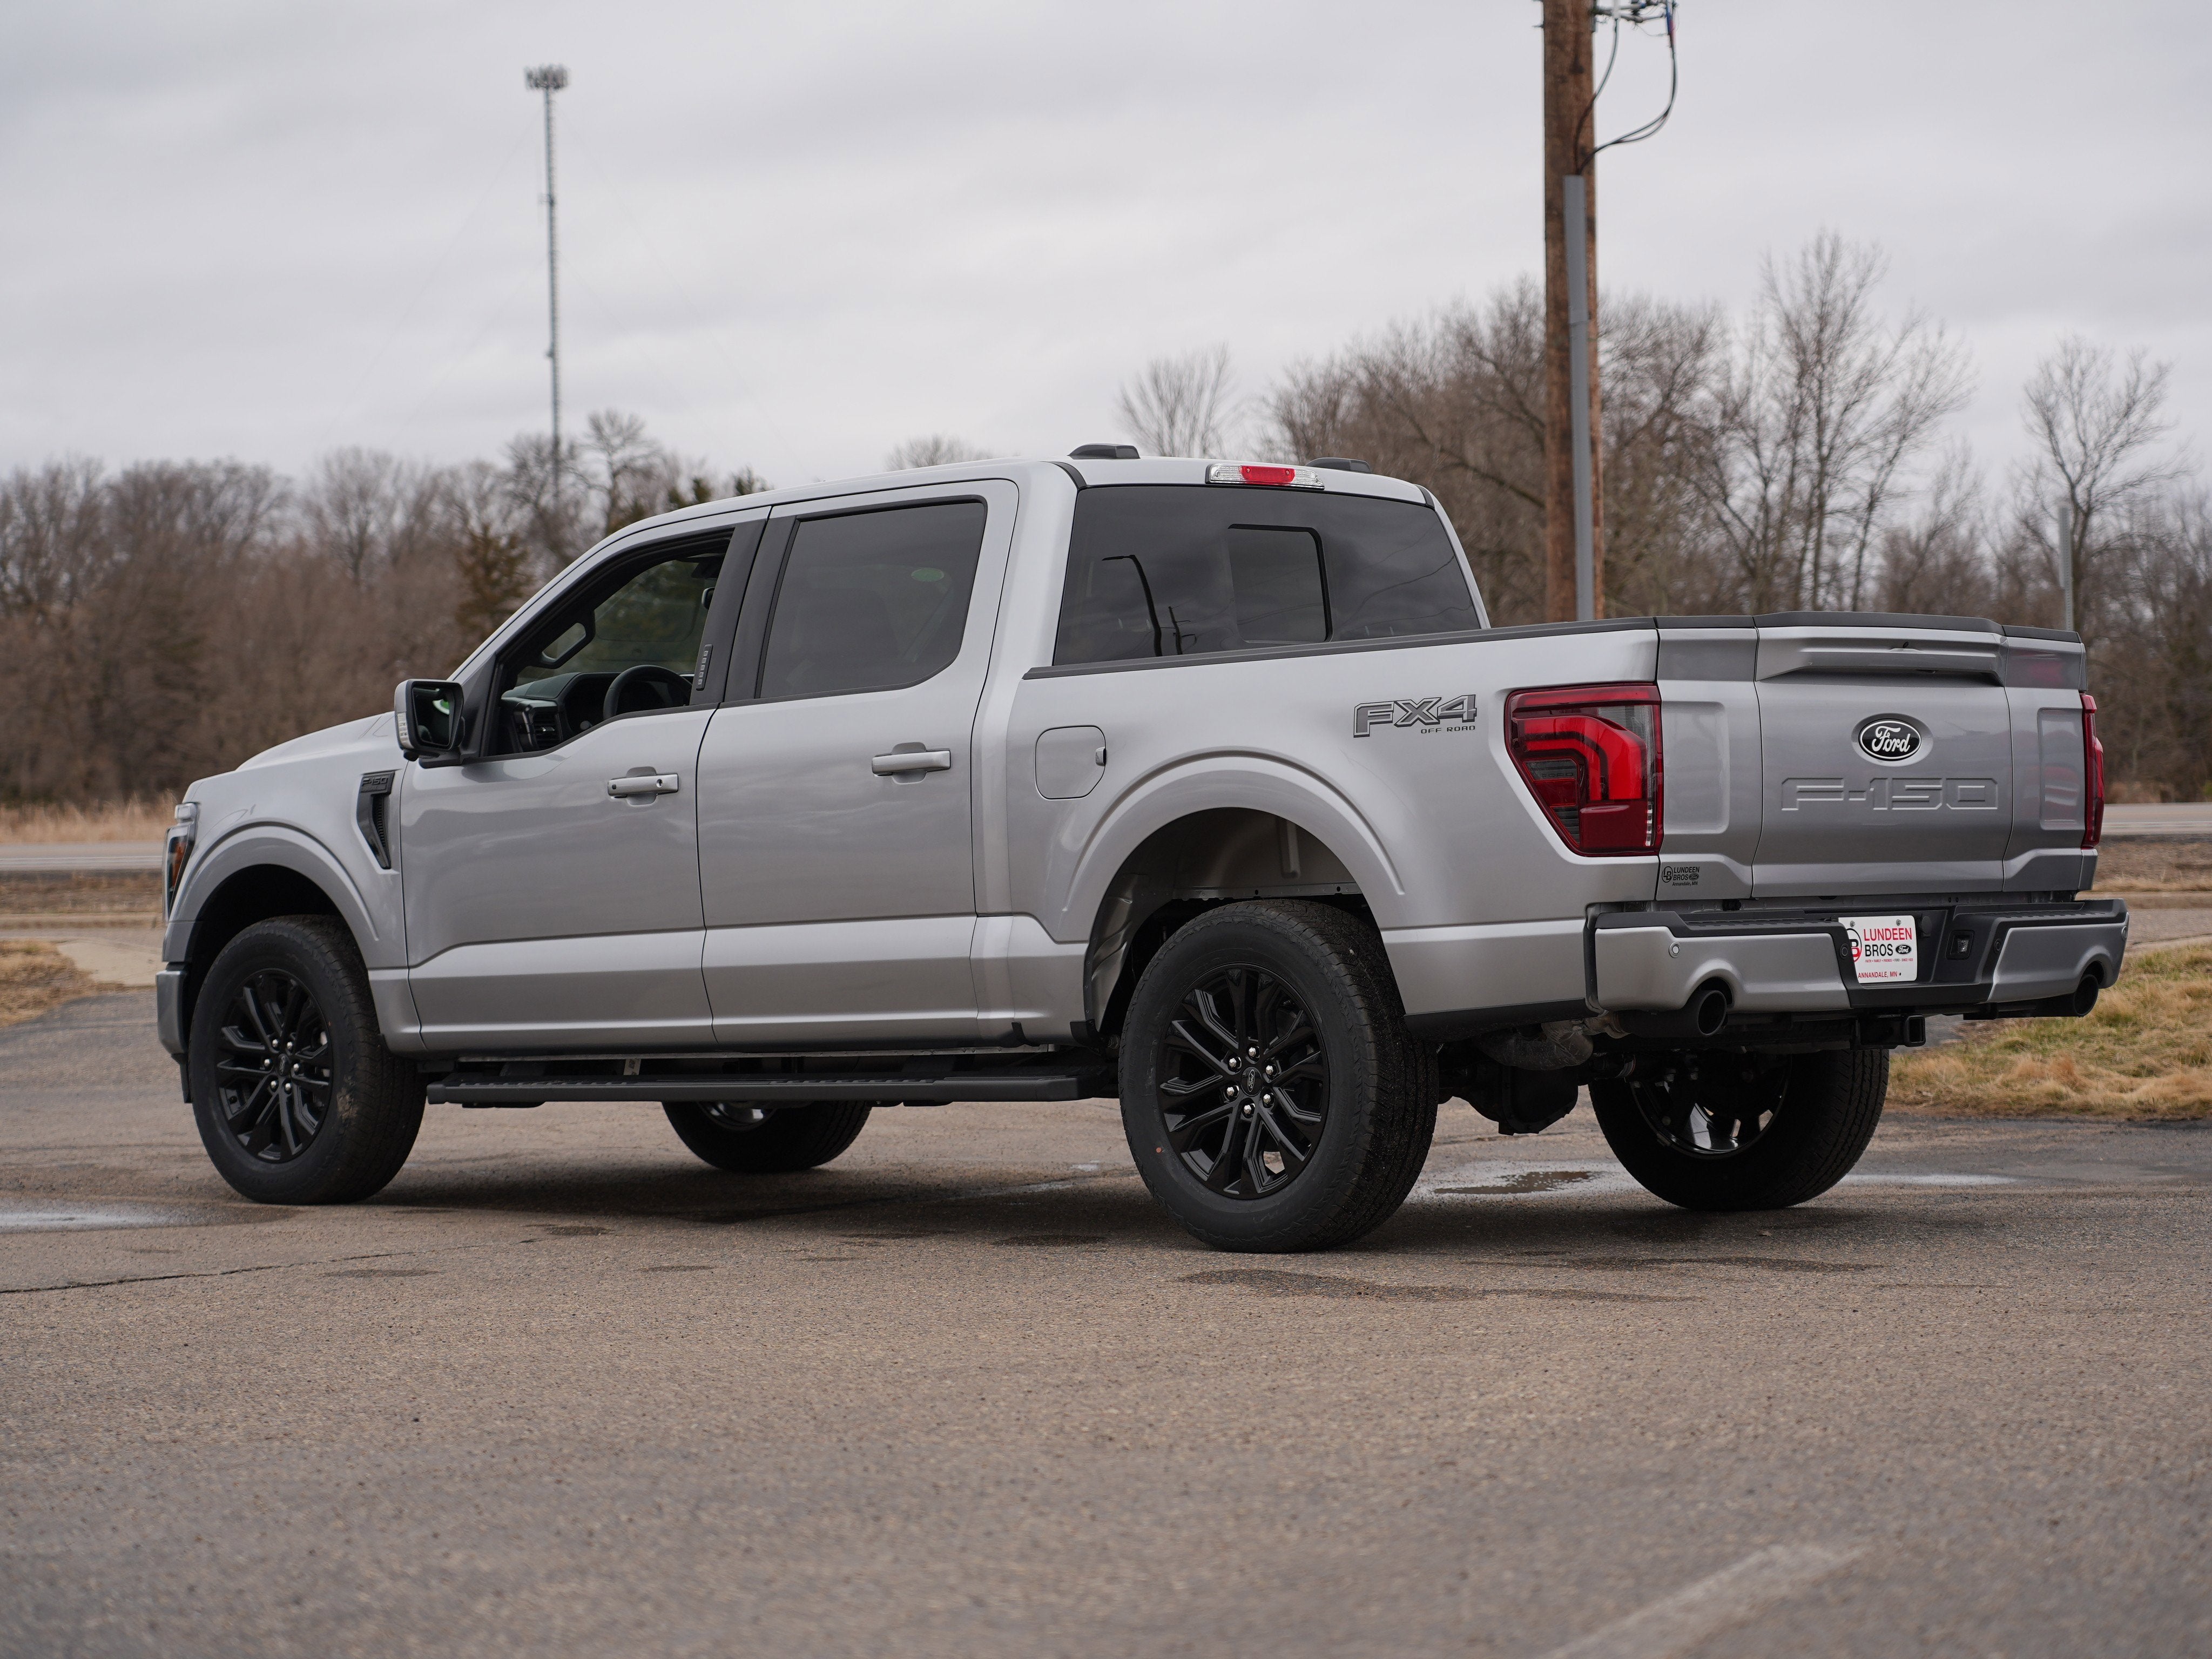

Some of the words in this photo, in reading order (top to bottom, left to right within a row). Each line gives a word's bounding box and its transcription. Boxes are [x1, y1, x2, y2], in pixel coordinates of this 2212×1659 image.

[1353, 694, 1477, 738] FX4
[1871, 725, 1911, 753] Ford
[362, 776, 388, 785] F-150
[1782, 777, 1998, 811] F-150
[1864, 928, 1912, 941] LUNDEEN
[1865, 943, 1893, 957] BROS
